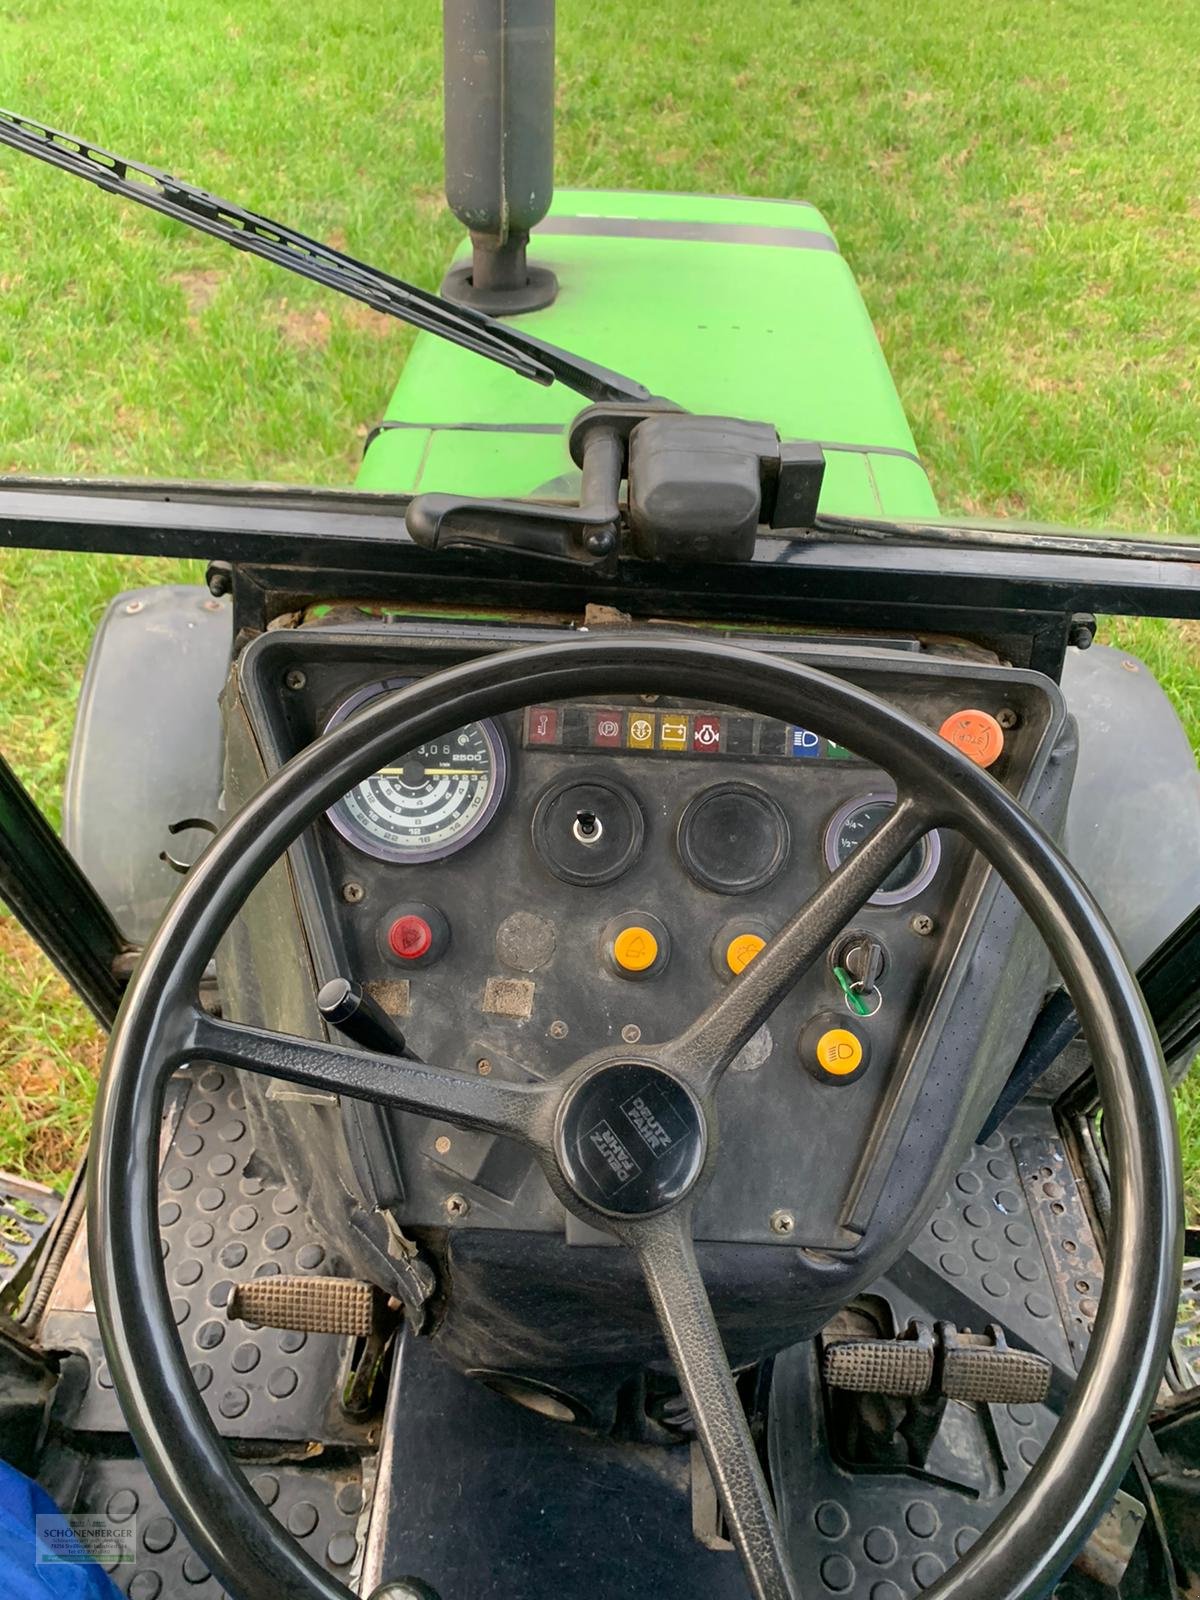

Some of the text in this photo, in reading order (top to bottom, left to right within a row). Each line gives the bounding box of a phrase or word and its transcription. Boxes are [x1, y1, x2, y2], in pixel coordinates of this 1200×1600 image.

[472, 796, 482, 808] 10
[841, 838, 851, 848] 1/2
[628, 1107, 660, 1149] FAHR
[632, 1097, 672, 1147] DEUTZ
[590, 1132, 630, 1181] DEUTZ
[602, 1130, 634, 1171] FAHR
